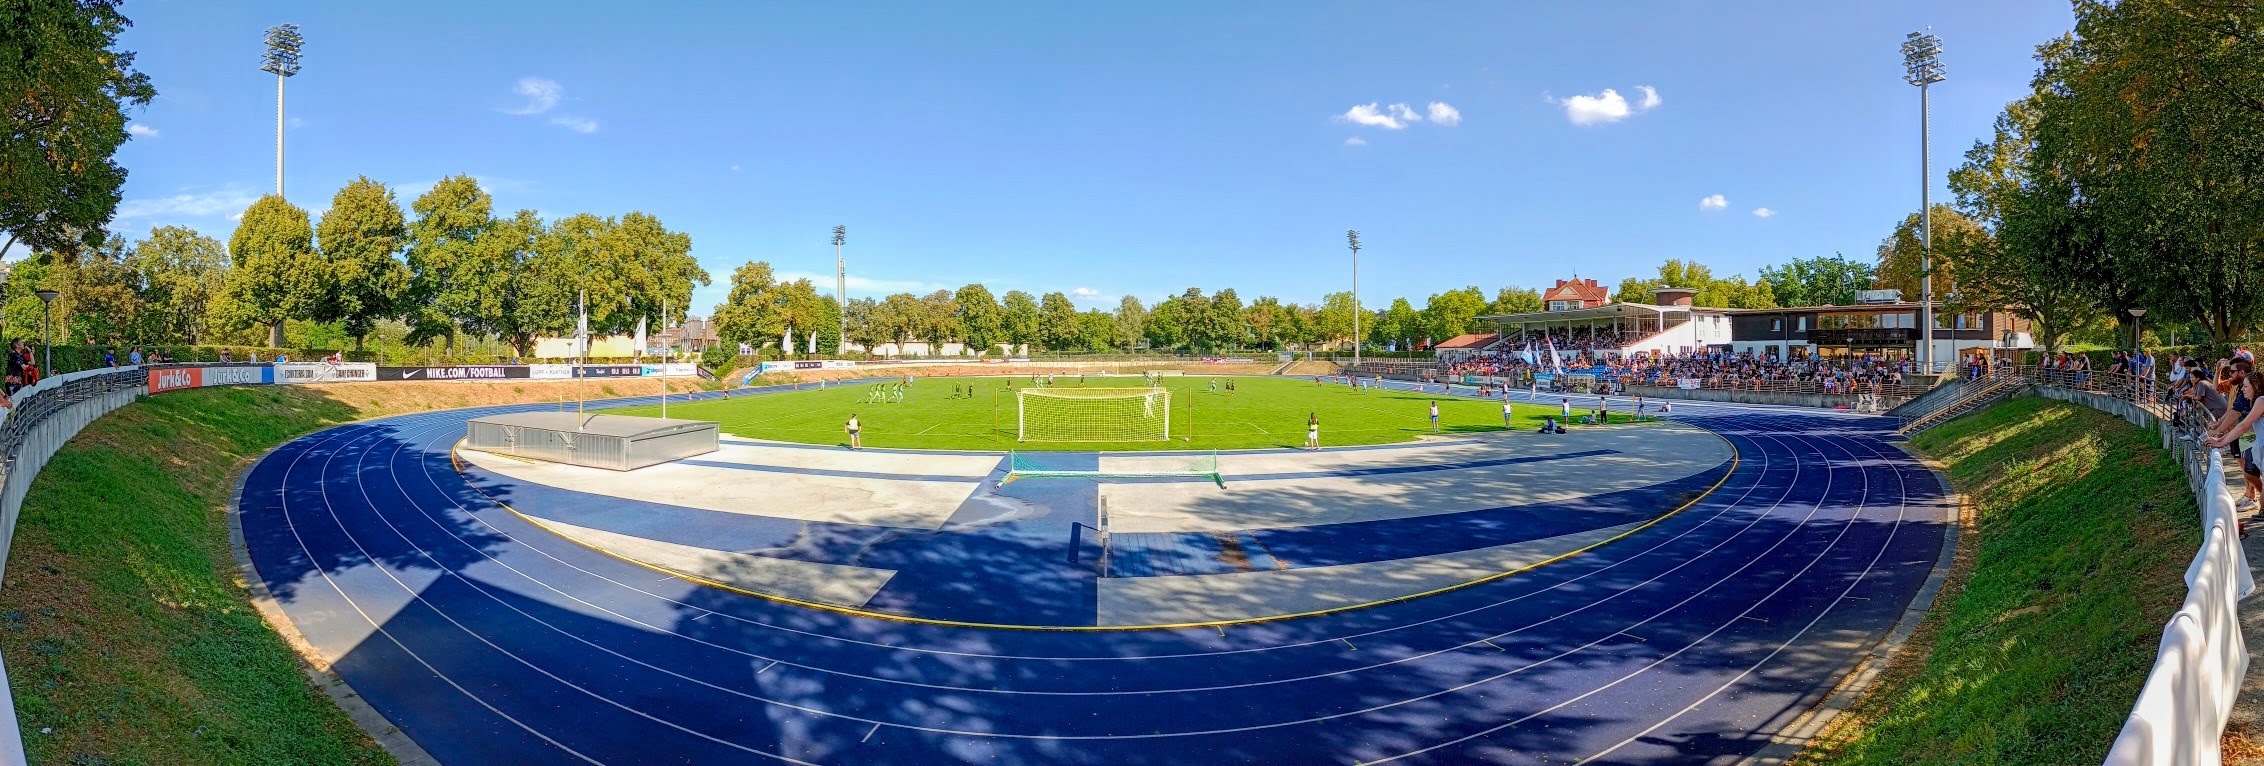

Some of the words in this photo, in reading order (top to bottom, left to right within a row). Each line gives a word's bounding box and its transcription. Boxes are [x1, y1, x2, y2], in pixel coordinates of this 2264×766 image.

[158, 369, 191, 390] Jurk&Co
[213, 367, 250, 385] Jurk&Co
[426, 368, 506, 378] NIKE.COM/FOOTBALL
